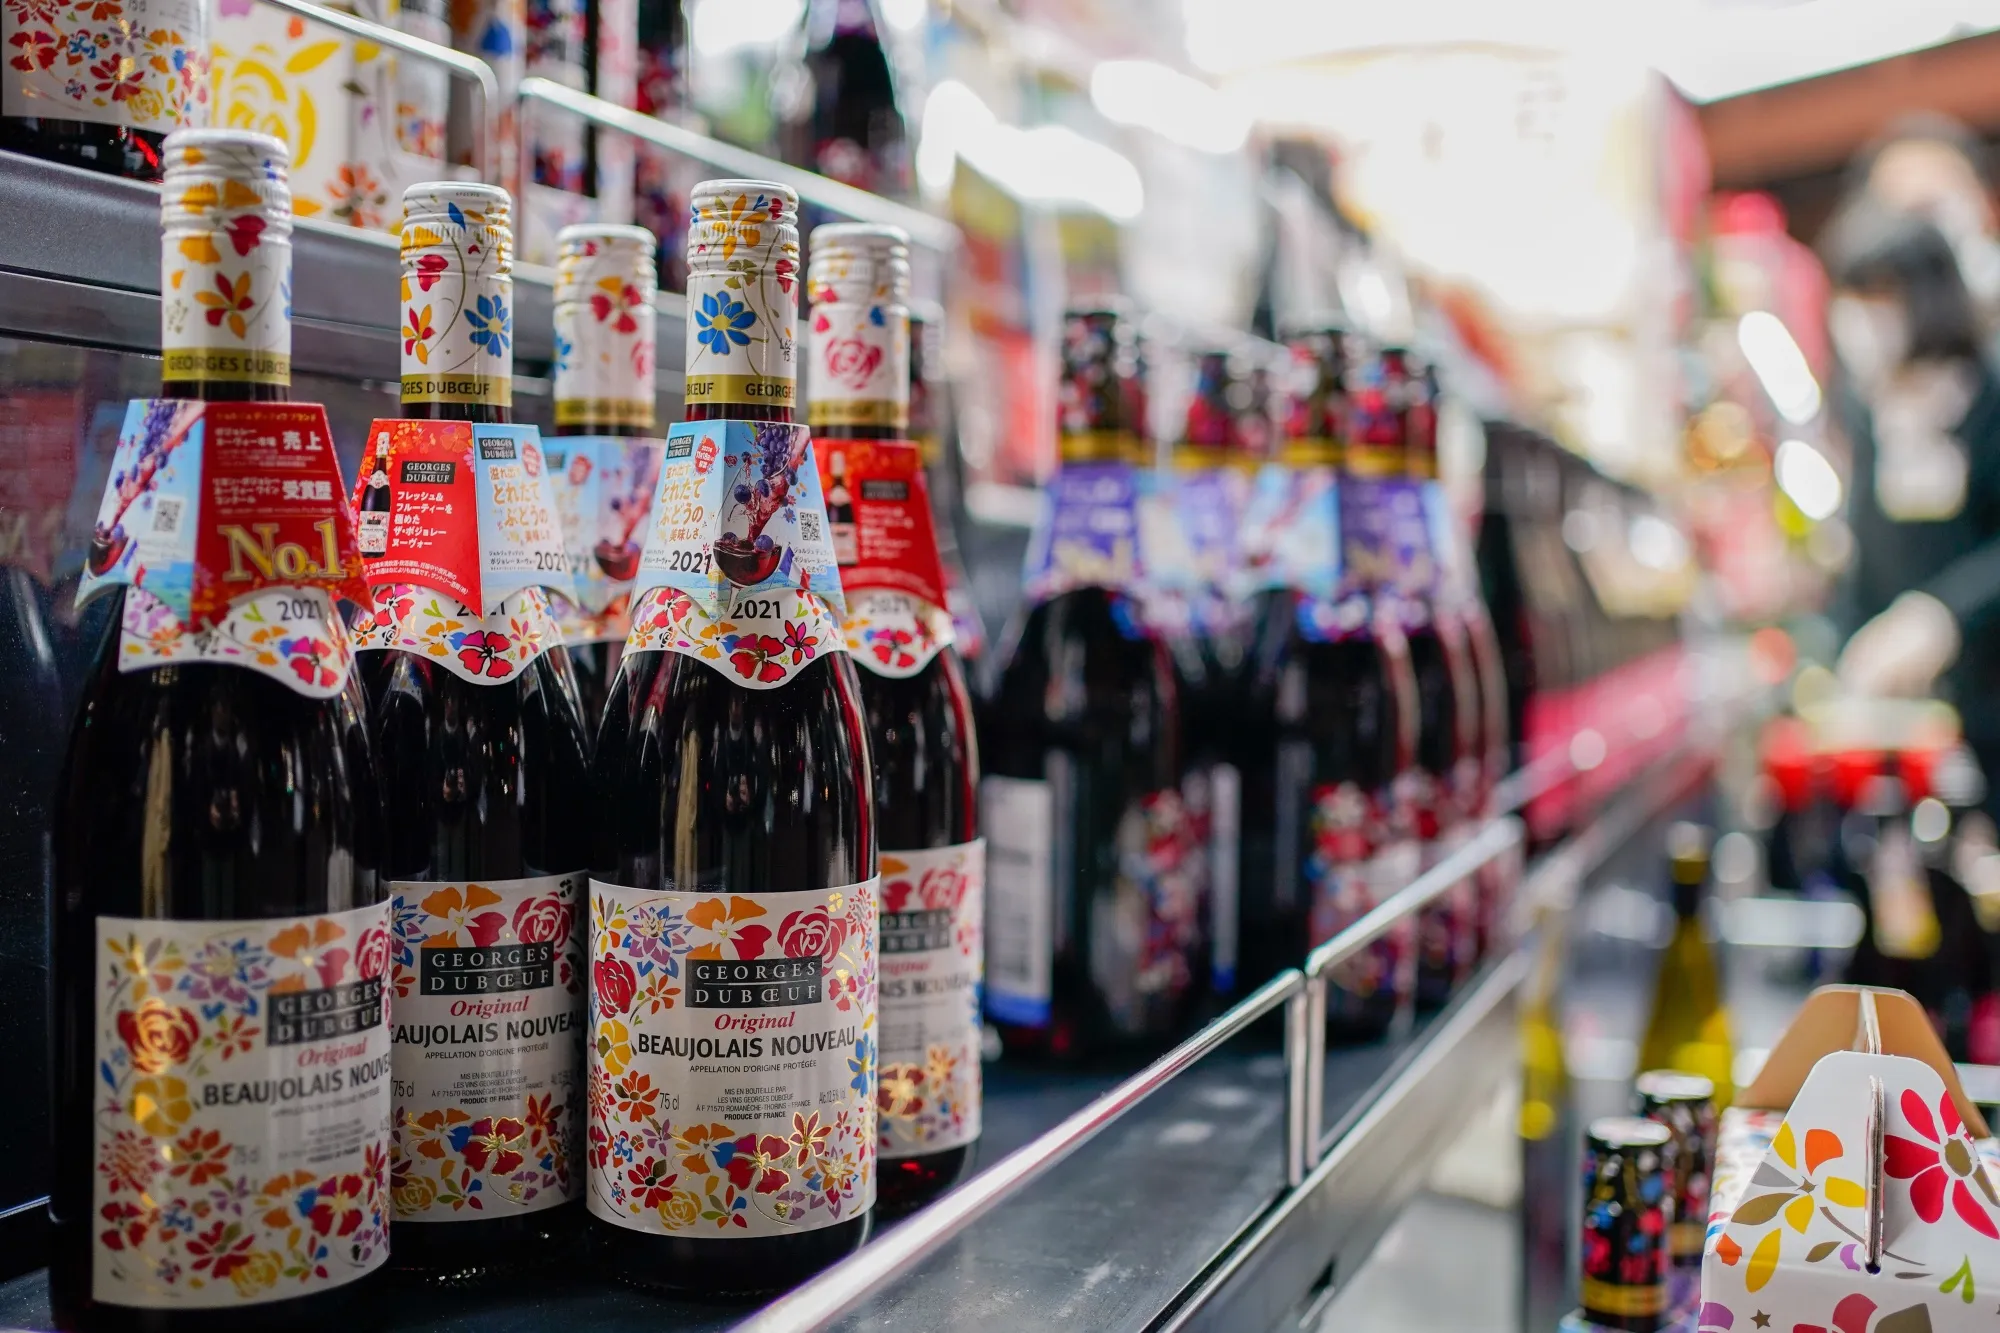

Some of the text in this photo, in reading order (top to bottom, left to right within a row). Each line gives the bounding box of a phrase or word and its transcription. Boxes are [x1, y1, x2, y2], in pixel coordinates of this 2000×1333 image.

[168, 356, 290, 375] GEORGES DUBŒ
[426, 381, 490, 396] DUBŒUF
[406, 462, 451, 472] GEORGES
[405, 473, 450, 483] DUBŒUF
[494, 481, 540, 505] とれたて
[661, 478, 706, 503] とれたて
[396, 503, 453, 514] フルーティーを
[660, 502, 704, 525] ぶどうの
[217, 517, 347, 582] No.1
[391, 538, 433, 549] ヌーヴォー
[535, 551, 567, 572] 2021
[670, 550, 713, 575] 2021
[276, 599, 323, 621] 2021
[731, 600, 781, 619] 2021
[432, 947, 548, 967] GEORGES
[696, 961, 816, 980] GEORGES
[431, 970, 549, 991] DUBŒUF
[278, 981, 380, 1015] GEORGES
[695, 985, 817, 1004] DUBŒUF
[450, 995, 530, 1019] Original
[277, 1007, 381, 1041] DUBŒUF
[506, 1010, 582, 1040] NOUVEA
[714, 1011, 796, 1035] Original
[297, 1037, 368, 1067] Original
[638, 1033, 763, 1061] BEAUJOLAIS
[771, 1025, 855, 1057] NOUVEAU
[425, 1051, 476, 1059] APPELLATION
[479, 1048, 515, 1057] D'ORIGINE
[689, 1060, 817, 1073] APPELLATION D'ORIGINE PROTÉGÉE
[204, 1070, 343, 1107] BEAUJOLAIS
[350, 1053, 391, 1088] NOUVE
[393, 1081, 415, 1098] 75 cl
[717, 1096, 729, 1104] LES
[729, 1096, 742, 1104] VINS
[743, 1095, 770, 1103] GEORGES
[745, 1086, 775, 1095] BOUTEILLE
[460, 1097, 488, 1105] PRODUCE
[659, 1093, 680, 1111] 75 cl
[791, 1100, 811, 1108] FRANCE
[724, 1113, 753, 1121] PRODUCE
[763, 1111, 786, 1119] FRANCE
